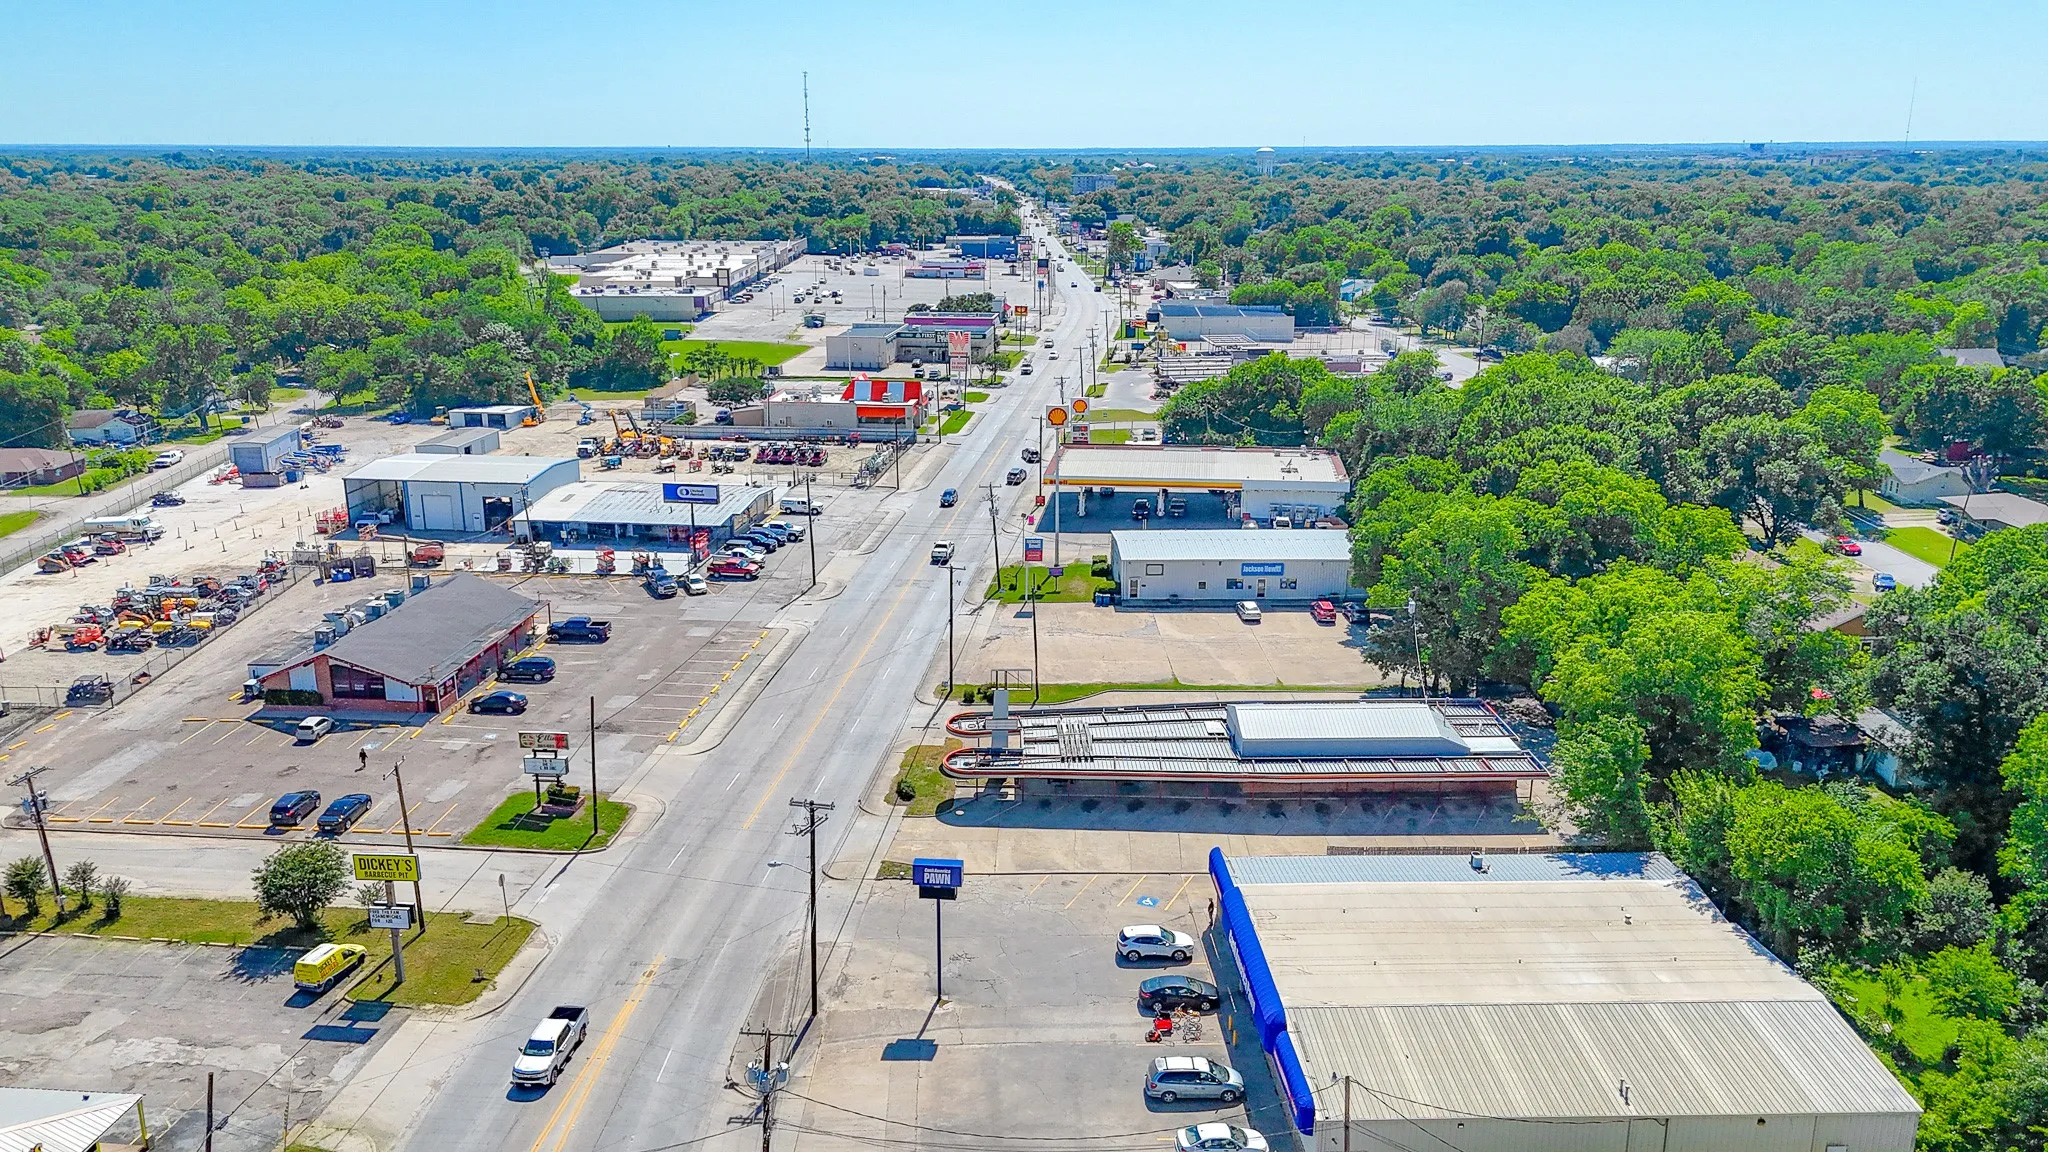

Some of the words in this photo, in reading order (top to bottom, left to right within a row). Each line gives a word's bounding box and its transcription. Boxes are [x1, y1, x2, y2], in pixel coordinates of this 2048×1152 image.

[358, 857, 413, 872] DICKEY'S
[398, 871, 409, 879] PIT
[924, 873, 950, 884] PAWN
